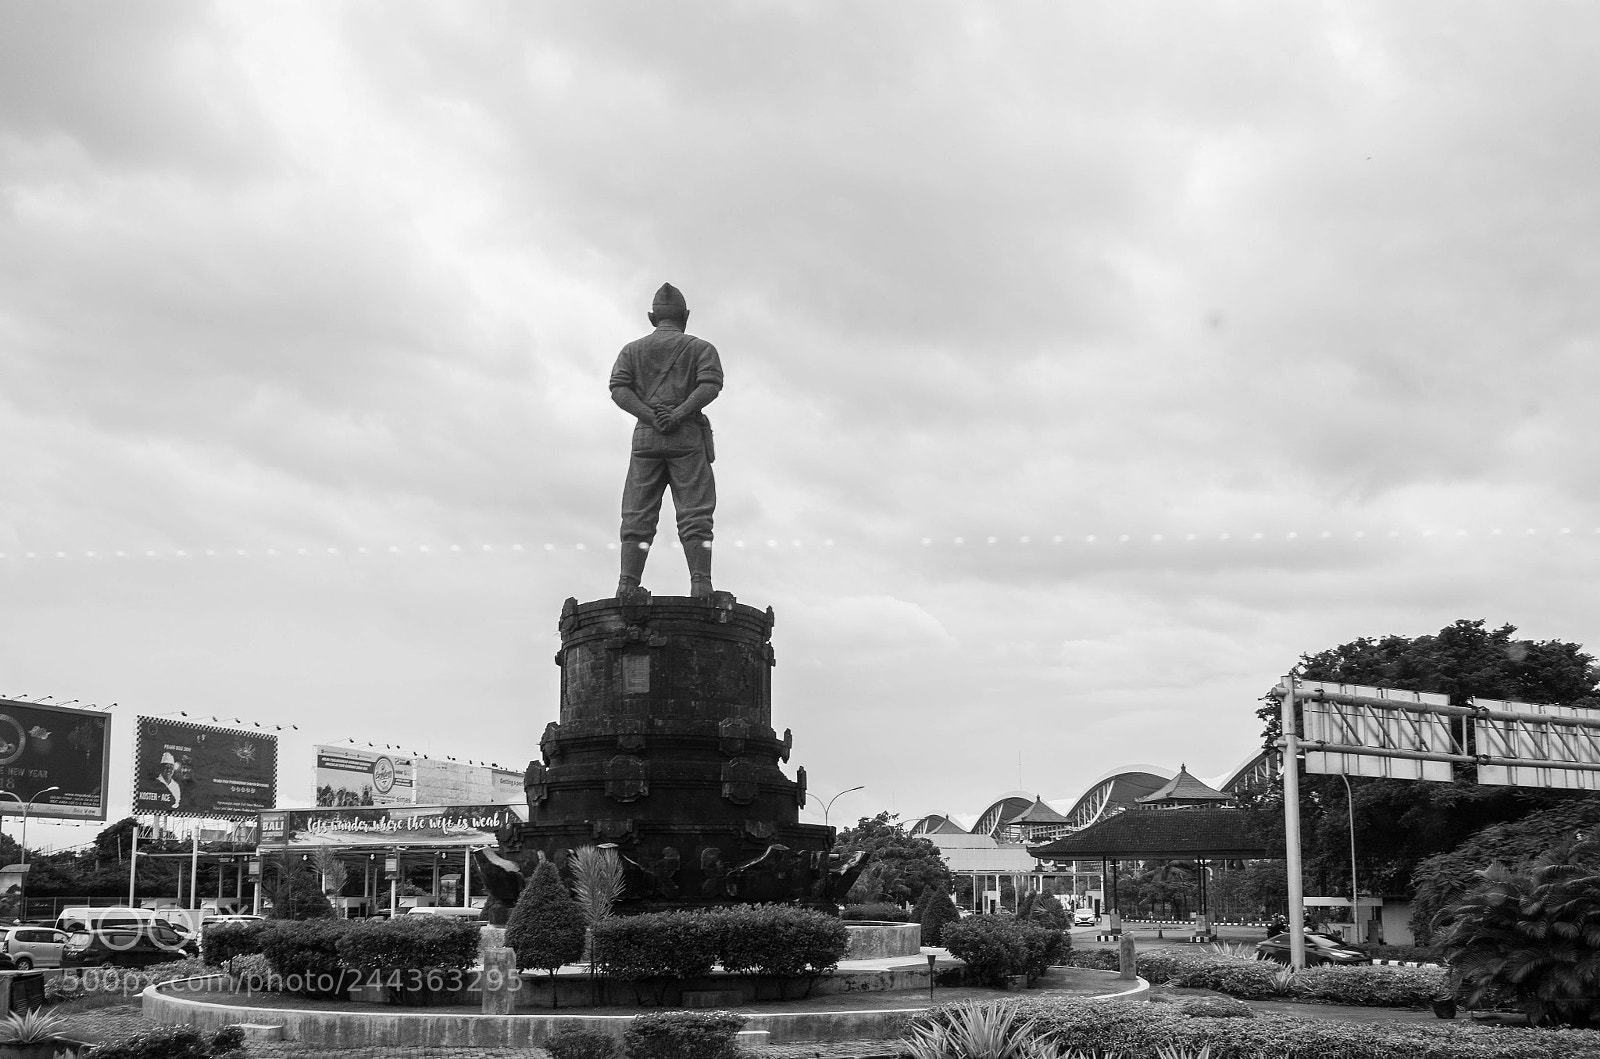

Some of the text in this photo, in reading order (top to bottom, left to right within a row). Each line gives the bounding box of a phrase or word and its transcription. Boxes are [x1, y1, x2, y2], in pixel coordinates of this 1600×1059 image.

[8, 767, 26, 776] NEW
[28, 768, 48, 778] YEAR
[138, 792, 158, 800] KOSTER
[262, 821, 284, 830] BALI
[372, 815, 403, 831] where
[407, 812, 426, 830] the
